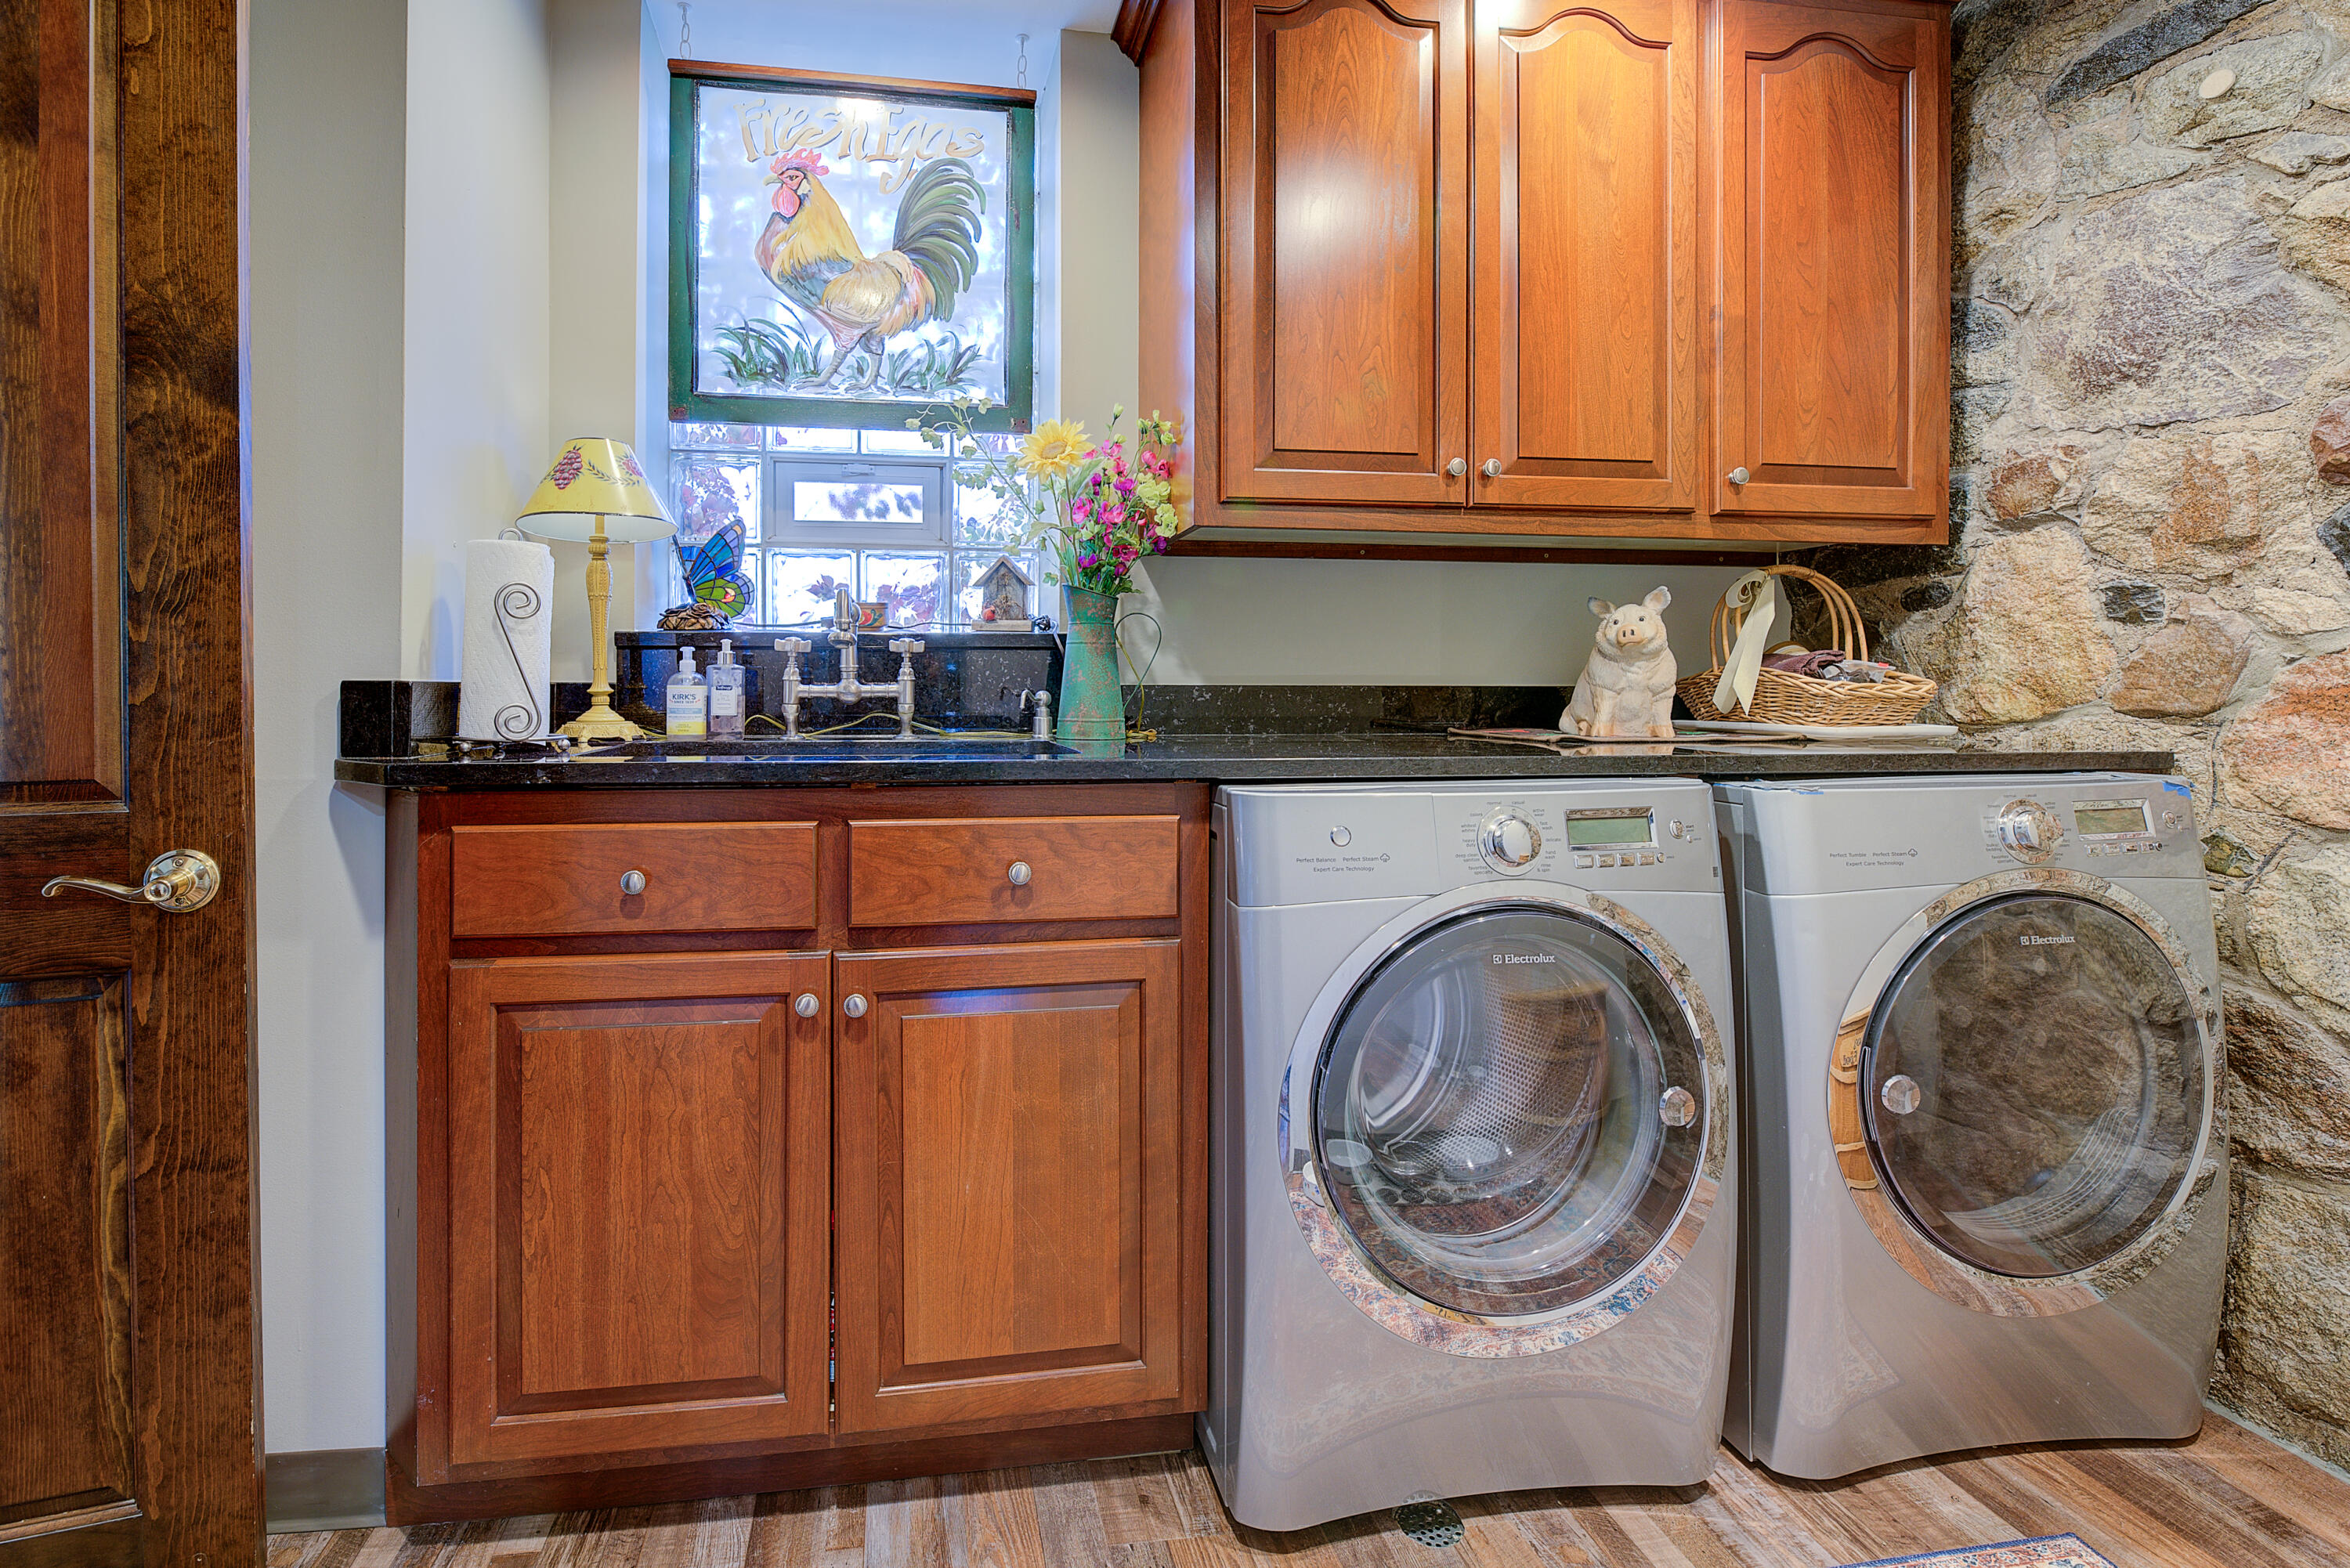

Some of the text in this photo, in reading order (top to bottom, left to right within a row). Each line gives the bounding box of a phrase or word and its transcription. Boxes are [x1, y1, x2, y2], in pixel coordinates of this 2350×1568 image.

[733, 99, 868, 162] Fresh
[2030, 934, 2075, 945] Electrolux
[1504, 953, 1556, 964] Electrolux
